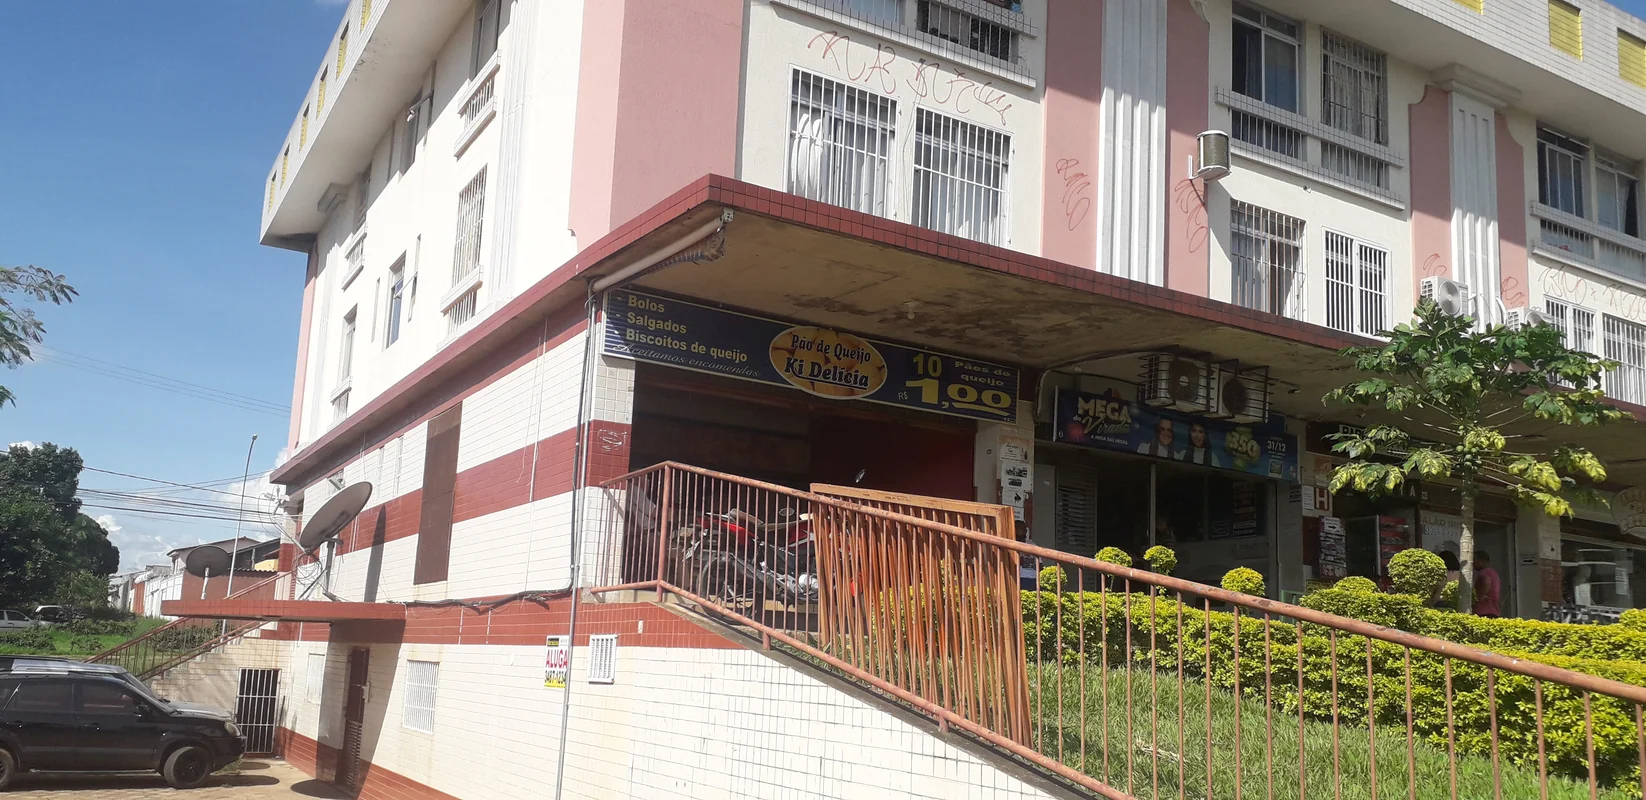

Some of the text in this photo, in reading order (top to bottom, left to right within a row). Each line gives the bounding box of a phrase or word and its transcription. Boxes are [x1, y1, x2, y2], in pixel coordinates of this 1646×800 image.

[628, 294, 665, 312] Bolos
[627, 311, 687, 334] Salgados
[626, 328, 748, 363] Biscoitos de queijo
[791, 334, 871, 364] Pão de Queijo
[612, 343, 760, 377] Aceitamos encomendas
[784, 357, 869, 387] Ki Delícia
[913, 353, 1011, 377] 10 Pães de
[961, 374, 1004, 386] queijo
[898, 378, 1012, 409] R$ 1,00
[1077, 396, 1132, 423] MEGA
[1081, 416, 1131, 434] Virada
[1227, 430, 1260, 458] 350
[1266, 440, 1287, 452] 31/12
[545, 649, 568, 669] ALUGA
